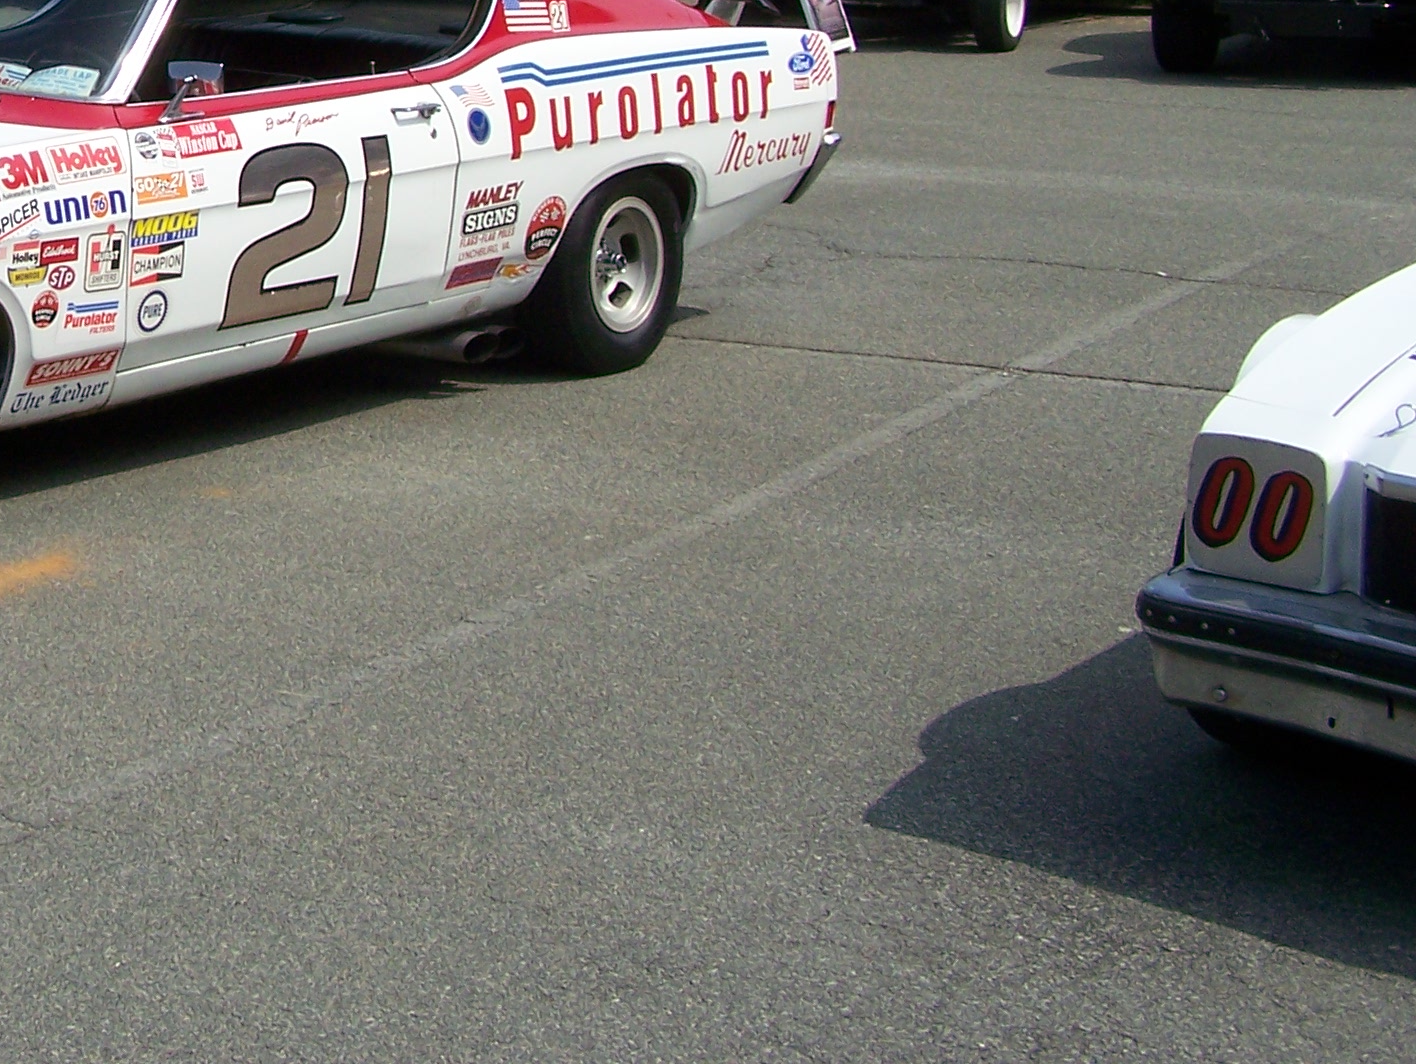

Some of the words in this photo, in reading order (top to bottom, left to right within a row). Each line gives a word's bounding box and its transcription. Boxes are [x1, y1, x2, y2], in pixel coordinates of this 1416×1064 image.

[550, 2, 569, 30] 21
[503, 63, 774, 162] Purolator
[177, 129, 220, 156] Winston
[219, 130, 239, 151] Cup
[188, 121, 218, 136] NASCAR
[50, 143, 123, 174] Holley
[714, 129, 812, 176] Mercury
[91, 197, 106, 211] 76
[465, 180, 525, 210] MANLEY
[133, 211, 198, 238] MOOG
[216, 135, 393, 331] 21
[464, 205, 517, 234] SIGNS
[12, 252, 39, 264] Holley
[134, 253, 181, 274] CHAMPION
[49, 267, 73, 288] STP
[63, 311, 118, 329] Purolator
[142, 302, 163, 319] PURE
[31, 349, 119, 380] SONNY'S
[10, 392, 44, 413] The
[48, 380, 110, 406] Ledger
[1190, 454, 1314, 564] 00
